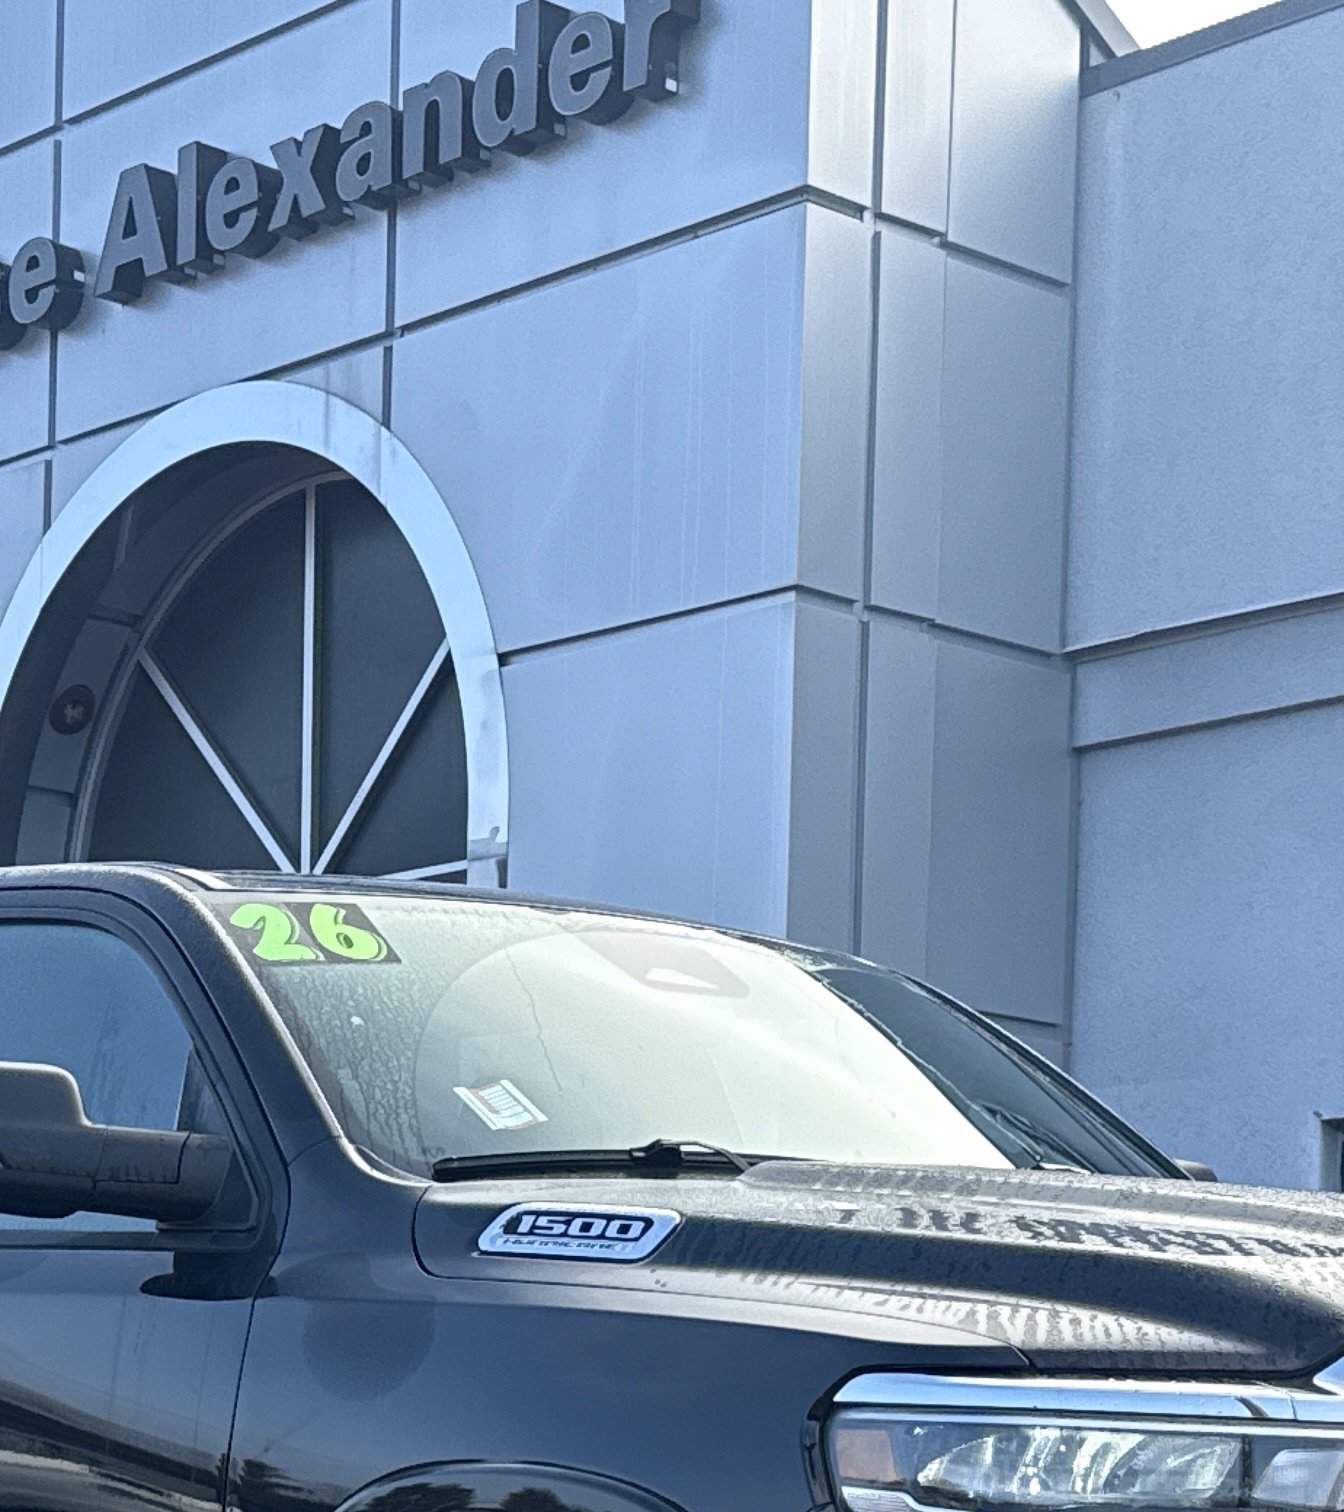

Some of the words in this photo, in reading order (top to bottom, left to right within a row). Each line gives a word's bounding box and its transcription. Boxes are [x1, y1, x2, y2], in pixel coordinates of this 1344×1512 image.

[95, 0, 698, 304] Alexander
[229, 903, 388, 962] 26
[516, 1214, 646, 1238] 1500
